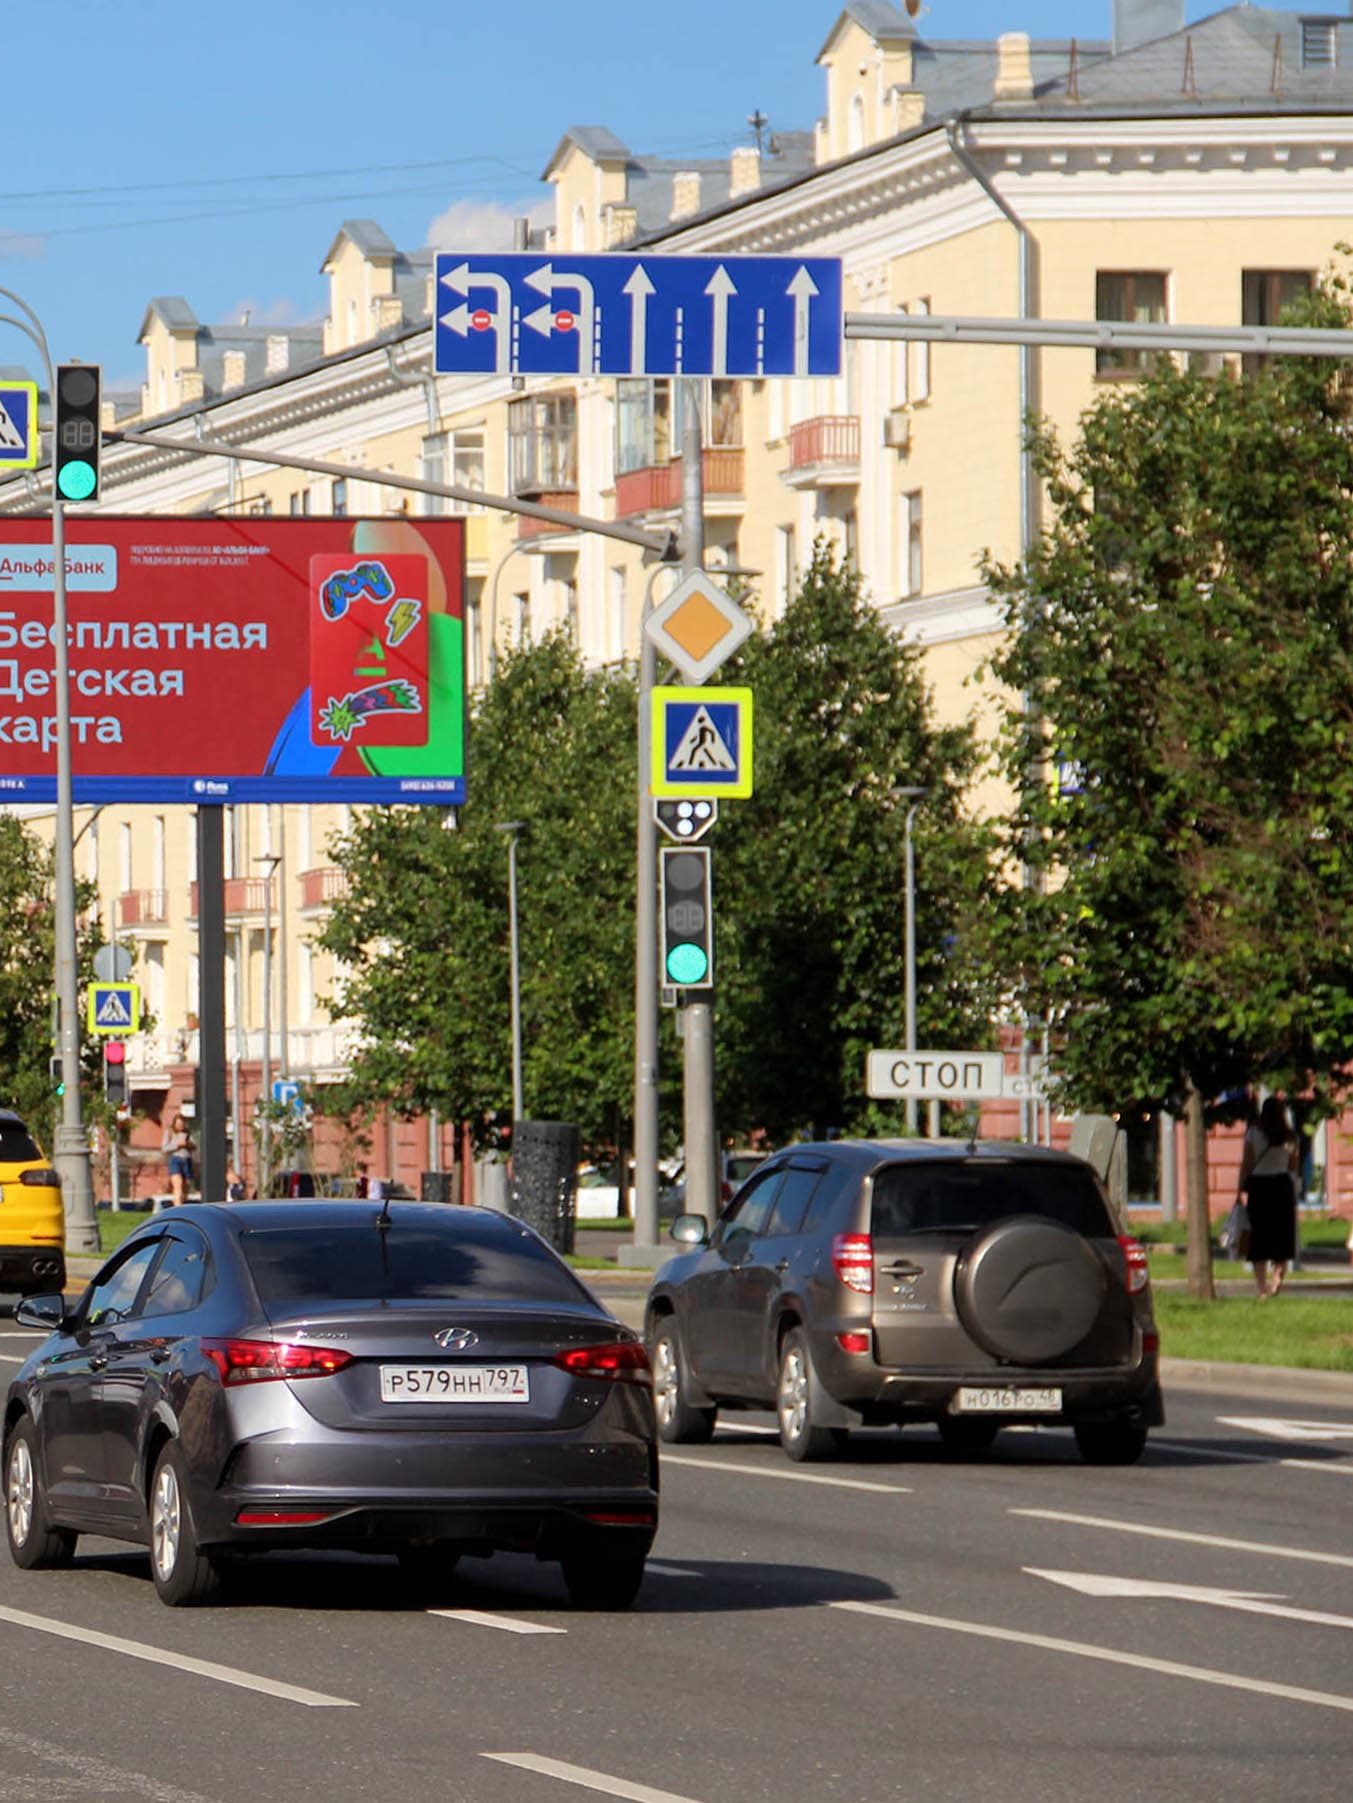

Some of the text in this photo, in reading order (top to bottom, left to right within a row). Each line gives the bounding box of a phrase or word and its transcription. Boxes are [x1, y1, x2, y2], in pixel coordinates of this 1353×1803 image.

[891, 1060, 983, 1088] СТОП
[391, 1369, 520, 1393] Р579НН 797
